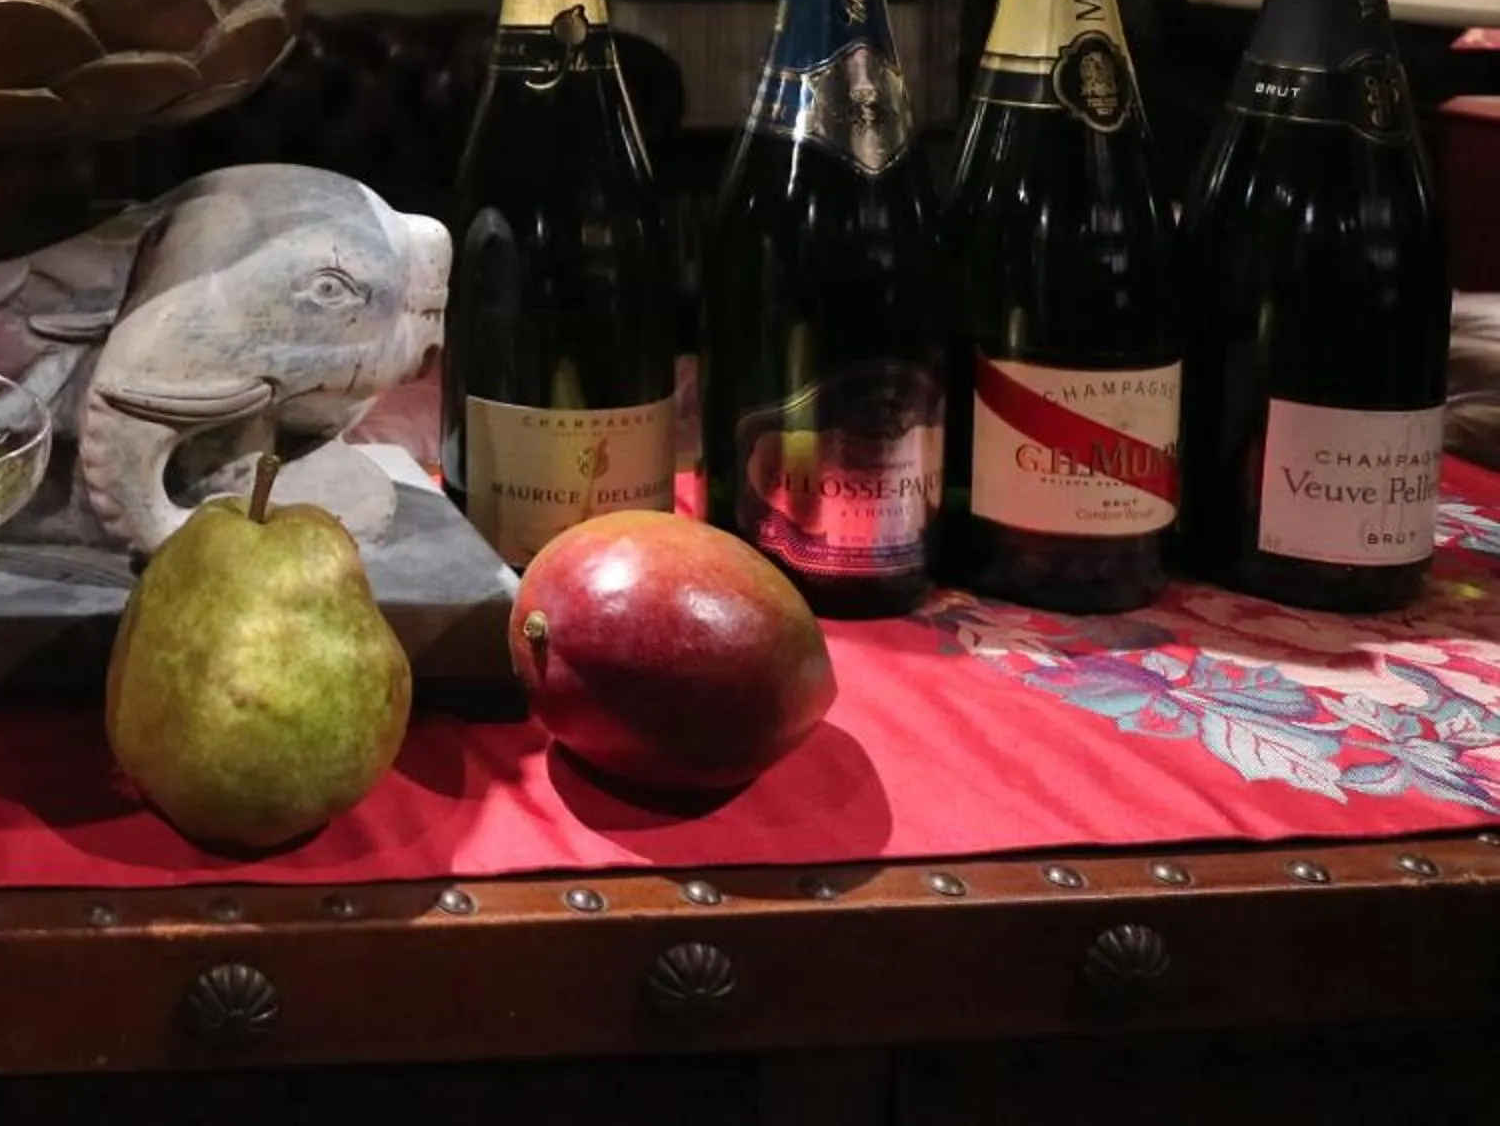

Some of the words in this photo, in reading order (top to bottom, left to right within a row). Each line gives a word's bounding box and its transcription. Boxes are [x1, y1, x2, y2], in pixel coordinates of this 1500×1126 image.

[1254, 81, 1301, 98] BRUT
[490, 481, 581, 505] MAURICE
[1281, 465, 1378, 505] Veuve
[1367, 531, 1416, 545] BRUT
